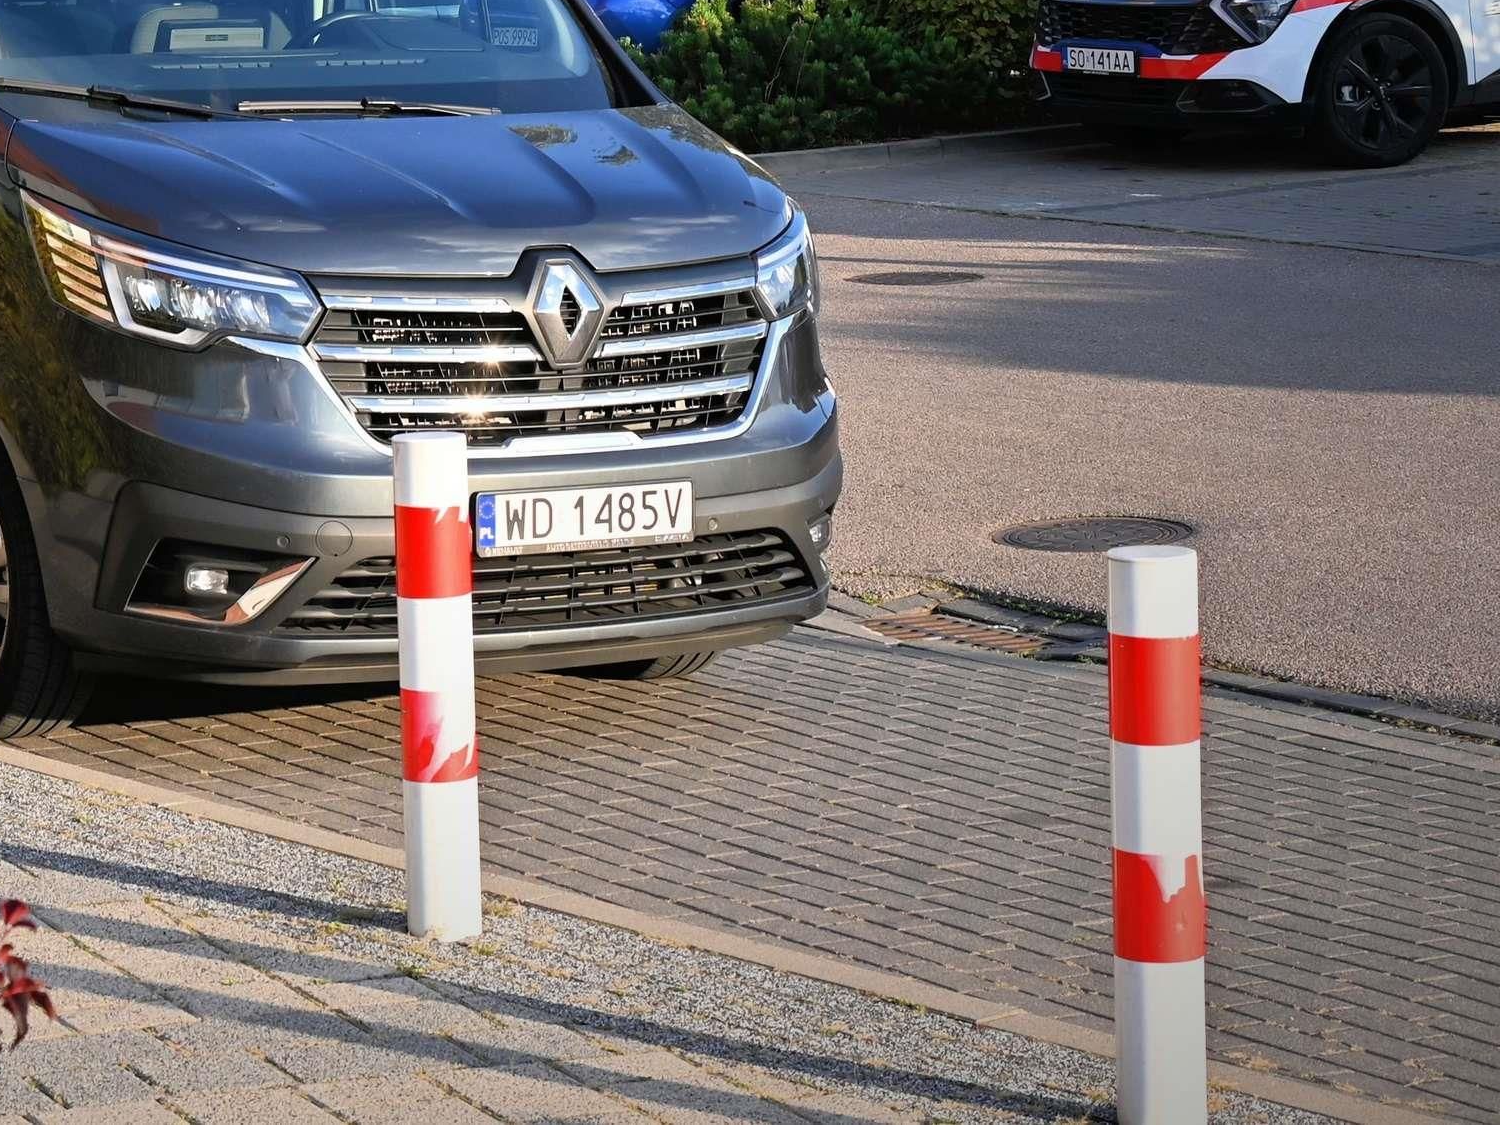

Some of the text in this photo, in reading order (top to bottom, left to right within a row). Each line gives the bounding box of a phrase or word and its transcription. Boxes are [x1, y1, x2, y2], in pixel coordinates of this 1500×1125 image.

[1069, 49, 1131, 72] SO 141AA
[505, 488, 683, 541] WD 1485V
[479, 527, 494, 540] PL
